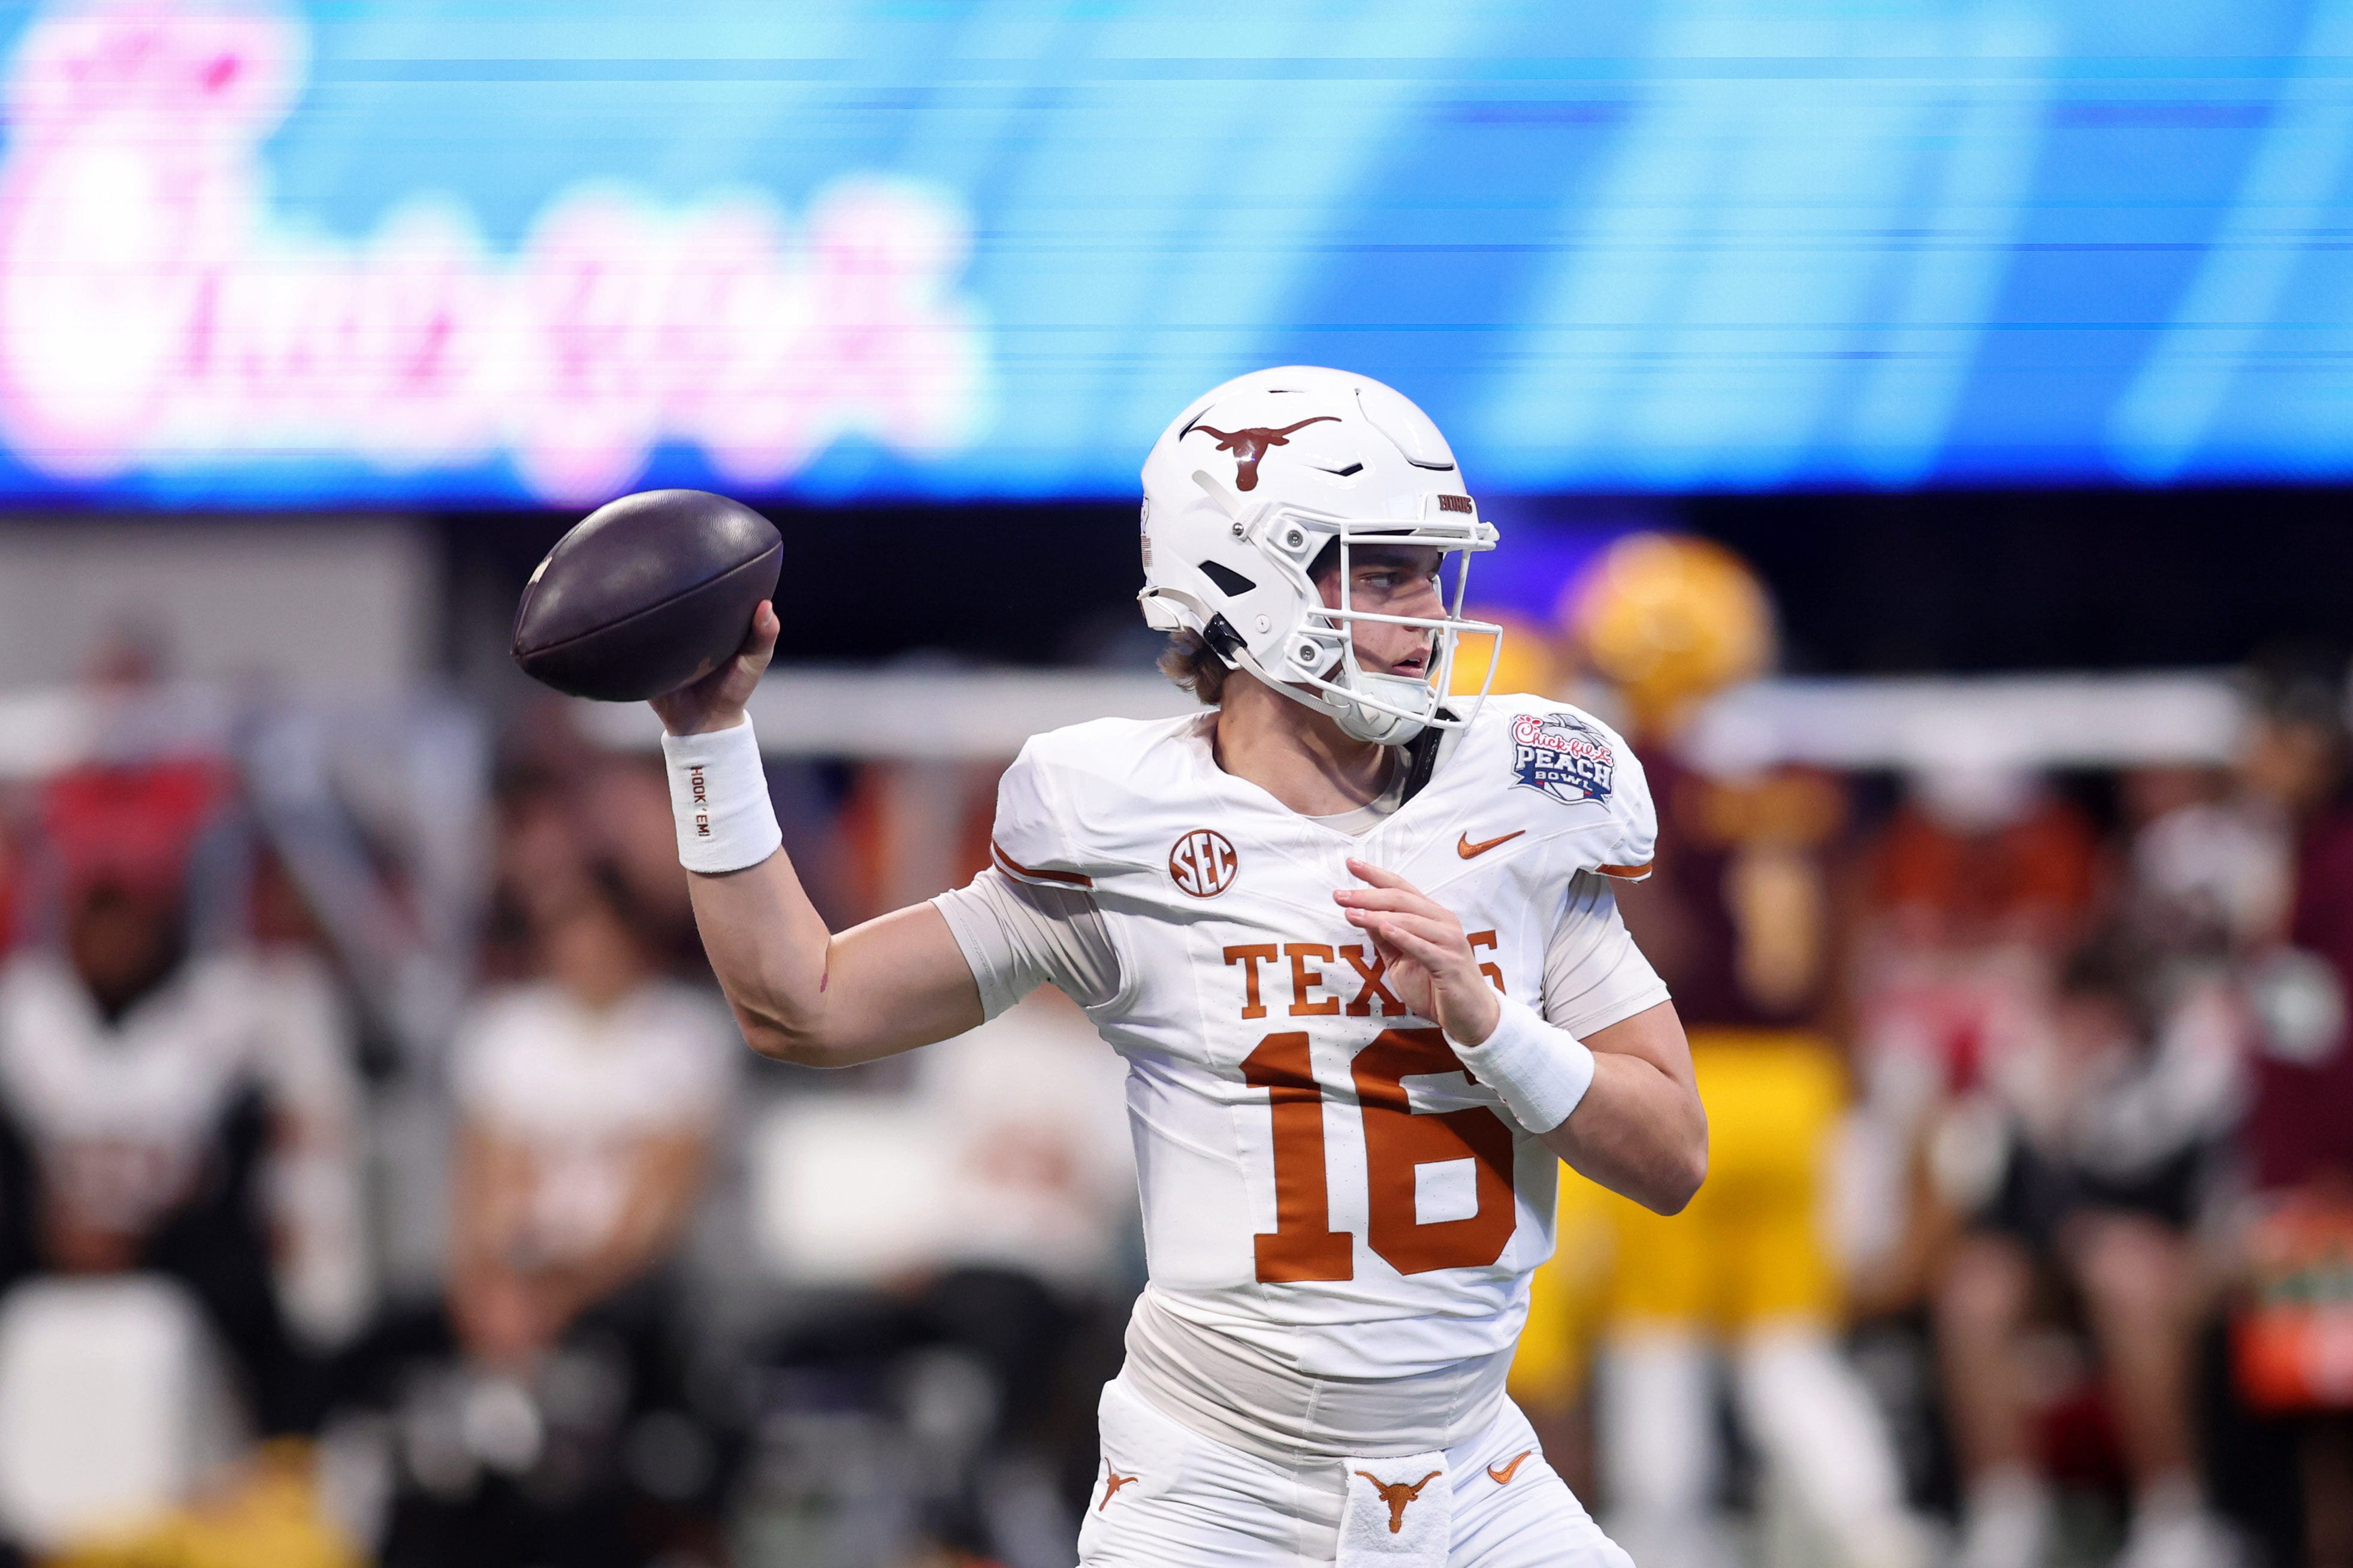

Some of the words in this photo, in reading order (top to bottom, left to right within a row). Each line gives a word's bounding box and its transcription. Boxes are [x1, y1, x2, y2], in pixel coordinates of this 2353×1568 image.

[1437, 495, 1472, 513] HORNS
[690, 765, 706, 803] HOOK
[1515, 746, 1612, 791] PEACH
[1535, 771, 1593, 791] BOWL
[1173, 833, 1234, 894] SEC
[1223, 930, 1506, 1019] TEXS
[1239, 1028, 1517, 1283] 16
